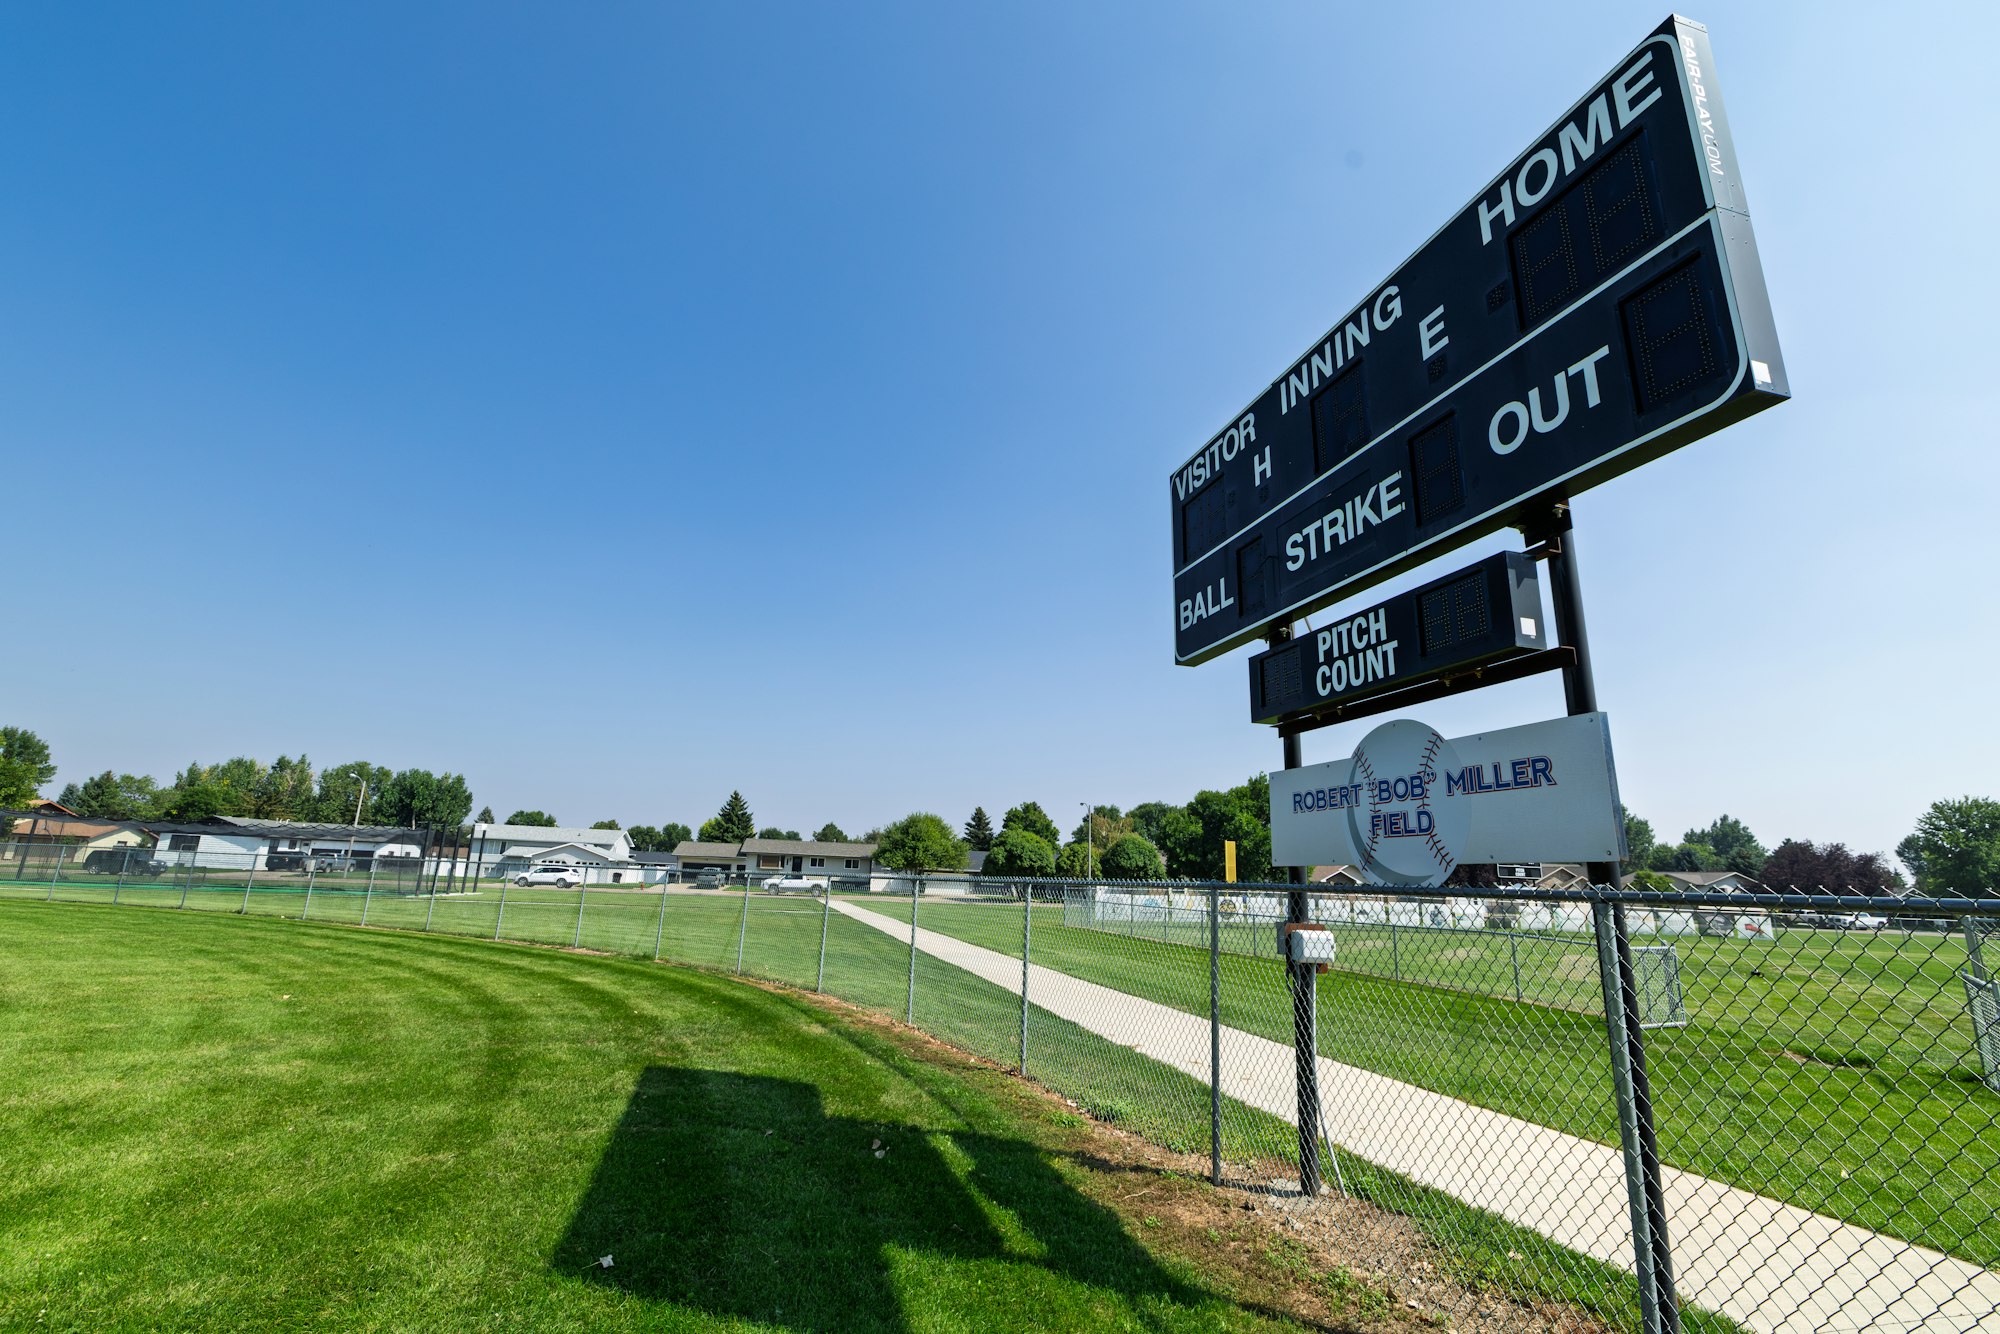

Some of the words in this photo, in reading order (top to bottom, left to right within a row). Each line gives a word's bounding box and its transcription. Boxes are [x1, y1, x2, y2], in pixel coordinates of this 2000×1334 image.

[1681, 34, 1725, 176] FAIR-PLAY.COM
[1477, 50, 1663, 246] HOME
[1280, 285, 1403, 416] INNING
[1418, 303, 1450, 362] E
[1488, 344, 1610, 455] OUT
[1175, 412, 1257, 502] VISITOR
[1253, 445, 1272, 488] H
[1285, 470, 1406, 572] STRIKE
[1179, 577, 1235, 632] BALL
[1317, 608, 1388, 663] PITCH
[1316, 640, 1399, 697] COUNT
[1293, 782, 1363, 814] ROBERT
[1444, 755, 1558, 797] MILLER
[1371, 808, 1435, 839] FIELD
